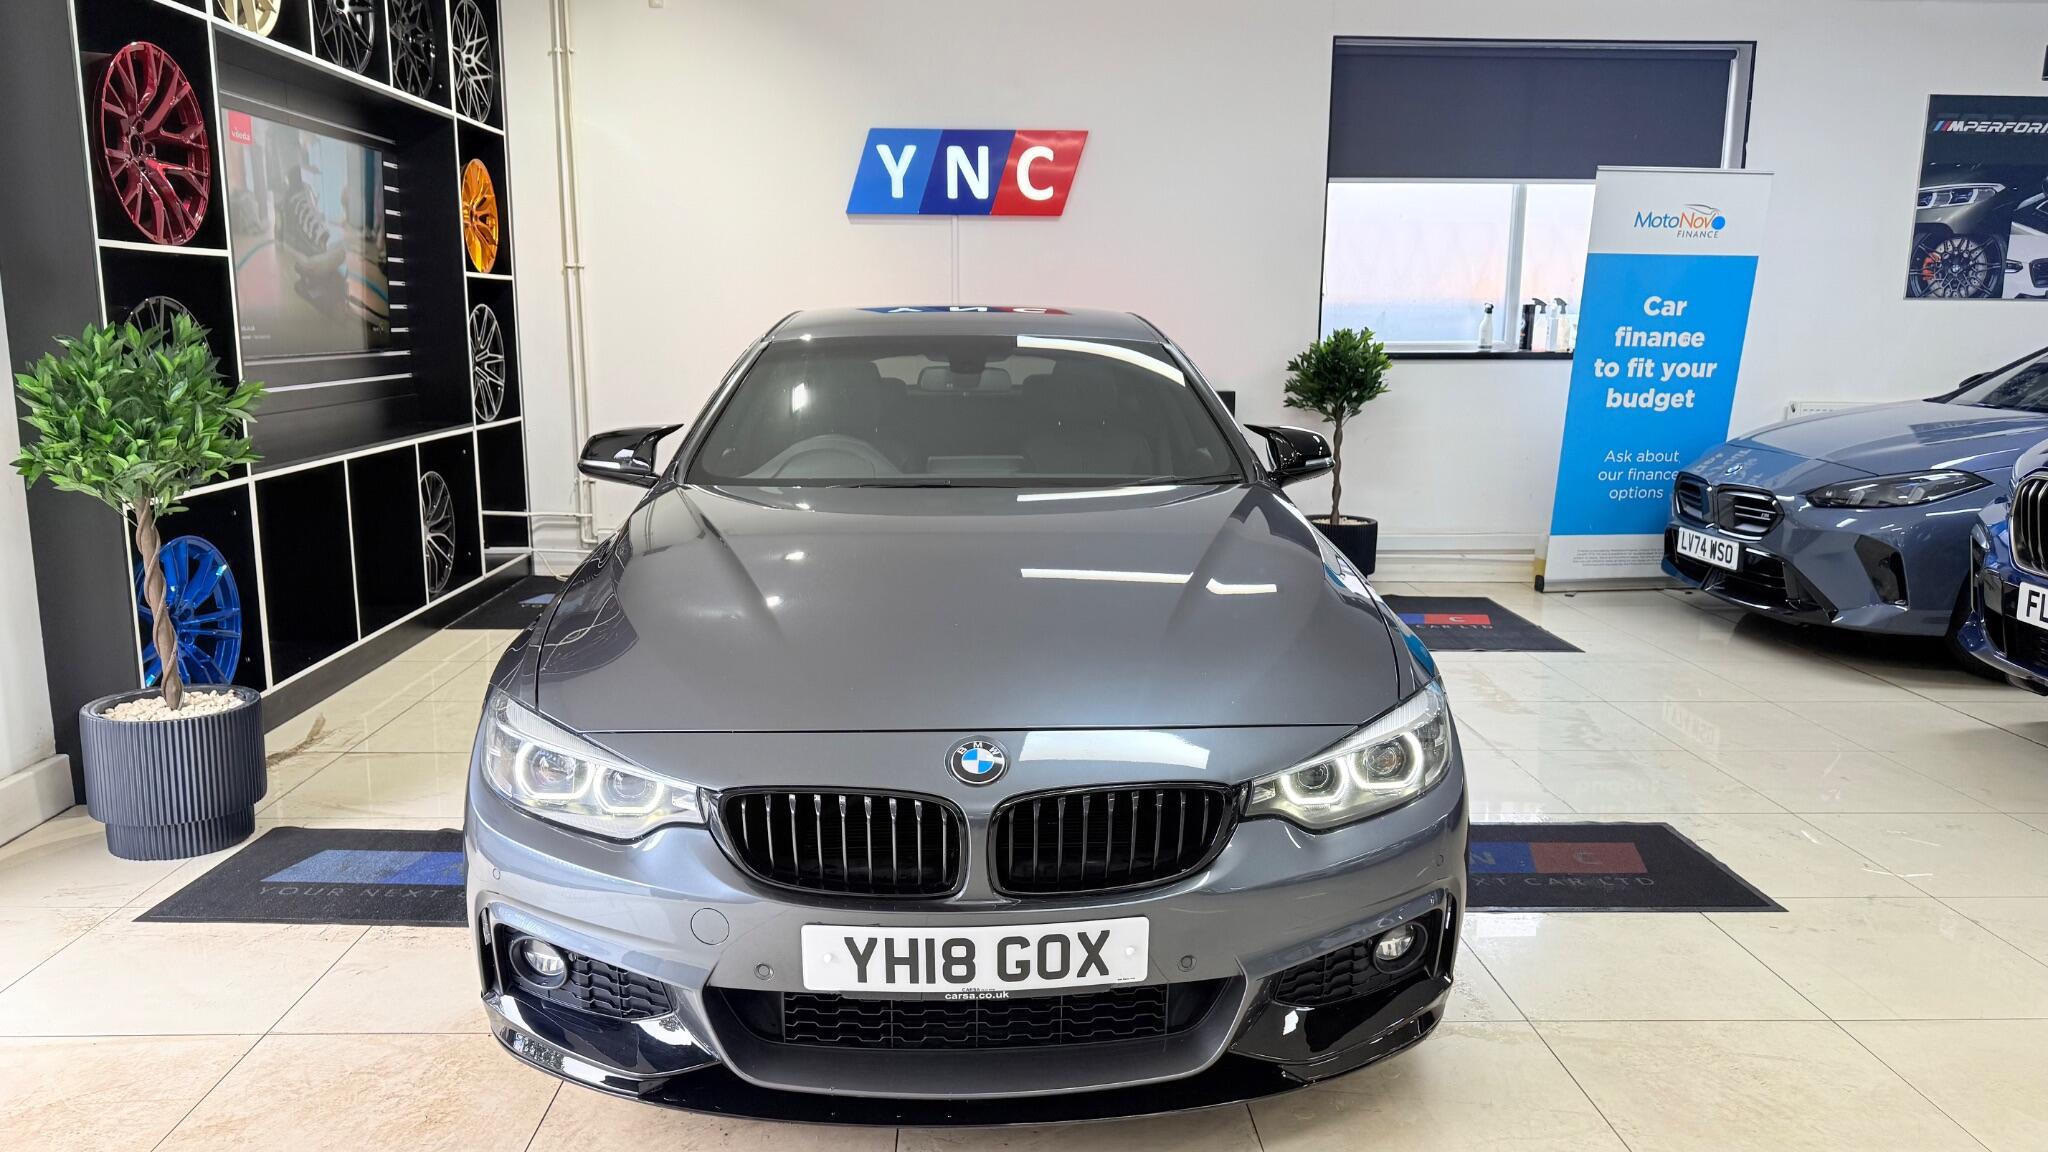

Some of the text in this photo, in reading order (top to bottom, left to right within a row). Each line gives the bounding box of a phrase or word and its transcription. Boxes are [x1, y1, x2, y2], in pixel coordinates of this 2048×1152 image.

[876, 144, 1054, 200] YNC
[1677, 230, 1719, 239] FINANCE
[1643, 295, 1688, 316] Car
[1615, 326, 1705, 347] finance
[1594, 357, 1718, 382] to fit your
[1606, 387, 1695, 412] budget
[1604, 449, 1680, 463] Ask about
[1598, 467, 1679, 481] our finance
[1609, 486, 1664, 501] options
[1681, 531, 1734, 564] LV74 WSO
[956, 741, 1001, 755] BMW
[1524, 877, 1585, 886] CAR
[1600, 877, 1655, 886] LTD
[260, 886, 444, 898] YOUR NEXT
[843, 929, 1111, 985] YH18 GOX
[944, 991, 1010, 1000] carsa.co.uk
